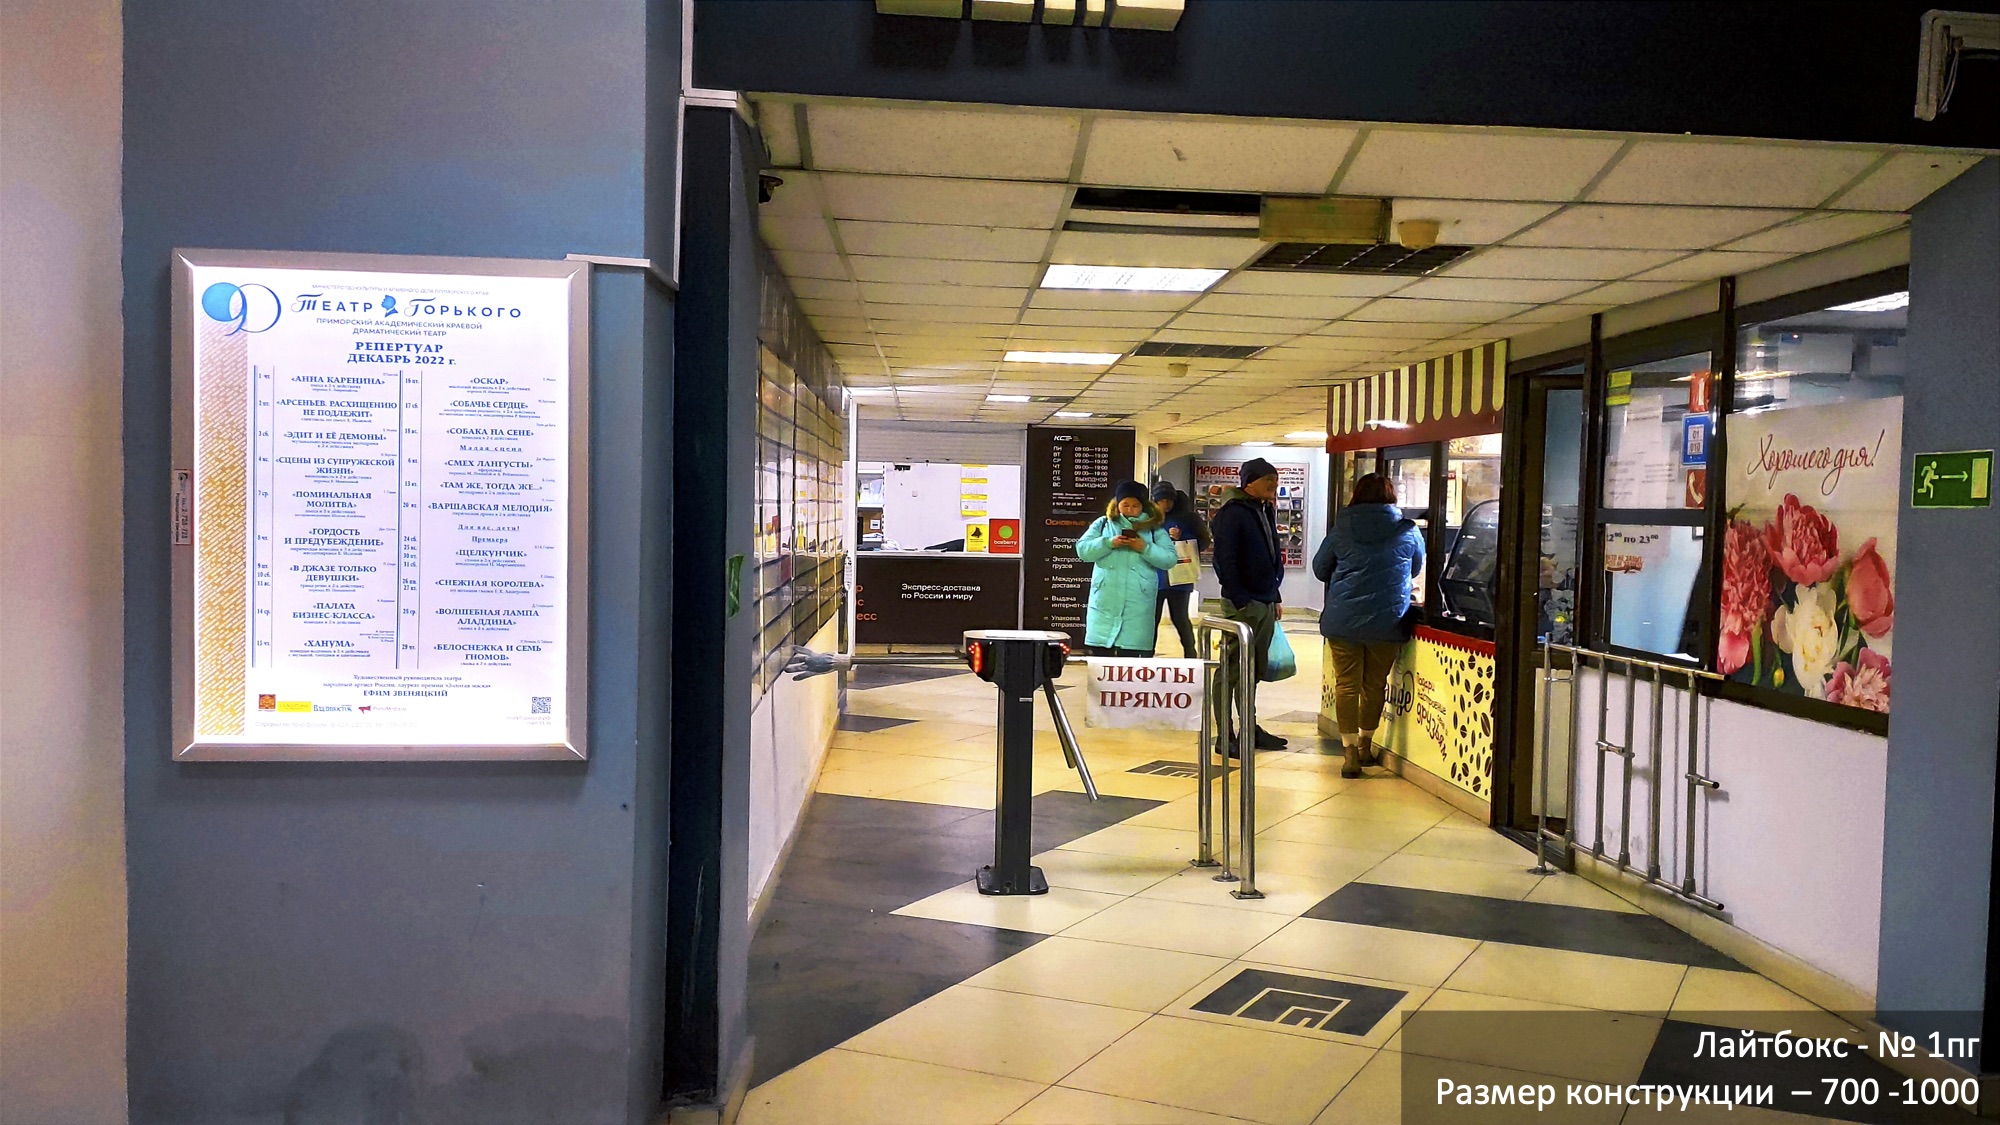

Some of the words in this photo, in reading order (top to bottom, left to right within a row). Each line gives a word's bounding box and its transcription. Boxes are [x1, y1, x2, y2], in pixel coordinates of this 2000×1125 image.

[292, 293, 372, 312] ТЕАТР
[404, 297, 521, 318] ГОРЬКОГО
[353, 327, 421, 335] ДРАМАТИЧЕСКИЙ
[356, 342, 443, 354] РЕПЕРТУАР
[347, 354, 410, 364] ДЕКАБРЬ
[415, 356, 444, 364] 2022
[330, 401, 397, 409] РАСХИЩЕНИЮ
[1692, 430, 1700, 439] 01
[327, 458, 394, 466] СУПРУЖЕСКОЙ
[1746, 433, 1833, 491] Хорошего
[1821, 428, 1885, 496] дня!
[486, 483, 515, 491] ТОГДА
[293, 491, 371, 499] «ПОМИНАЛЬНАЯ
[428, 503, 498, 511] «ВАРШАВСКАЯ
[502, 505, 552, 513] МЕЛОДИЯ»
[309, 528, 360, 536] «ГОРДОСТЬ
[295, 538, 384, 546] ПРЕДУБЕЖДЕНИЕ»
[472, 536, 507, 544] Премьера
[902, 583, 980, 592] Экспресс-доставка
[914, 591, 943, 599] России
[457, 618, 516, 626] АЛАДДИНА»
[304, 640, 354, 648] «ХАНУМА»
[1096, 666, 1195, 684] ЛИФТЫ
[1099, 691, 1192, 709] ПРЯМО
[1416, 702, 1447, 762] друзьям
